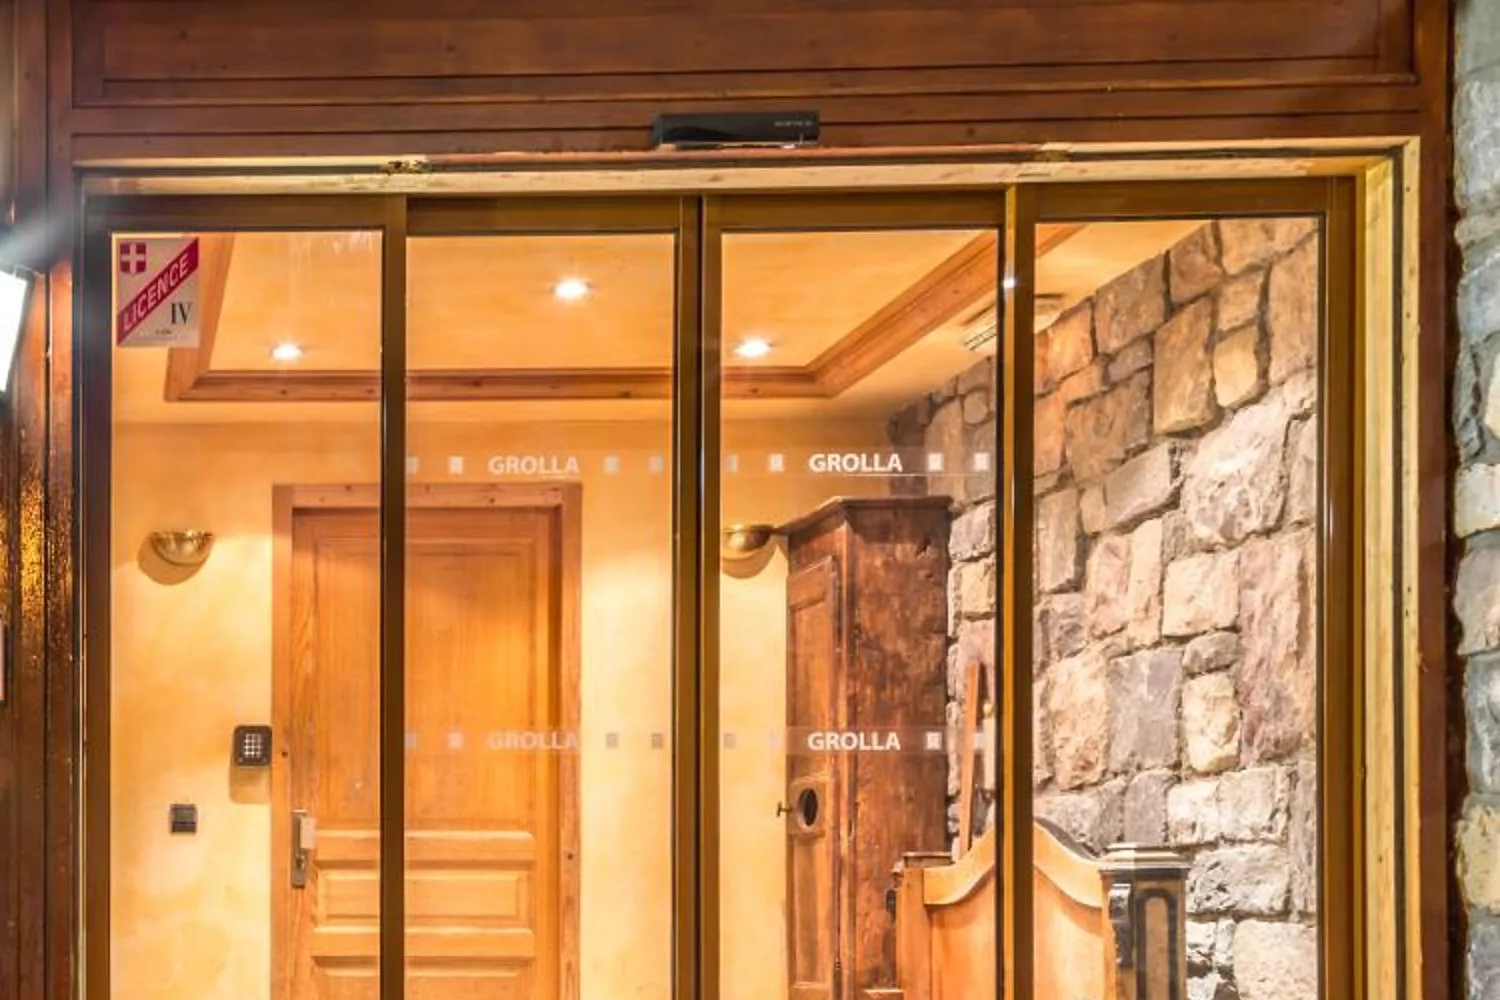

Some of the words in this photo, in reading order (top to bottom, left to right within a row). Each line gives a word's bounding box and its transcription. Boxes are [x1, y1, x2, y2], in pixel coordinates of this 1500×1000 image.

[123, 252, 189, 331] LICENCE
[170, 302, 193, 325] IV
[487, 455, 580, 475] GROLLA
[808, 453, 903, 473] GROLLA
[485, 731, 579, 751] GROLLA
[807, 731, 901, 751] GROLLA
